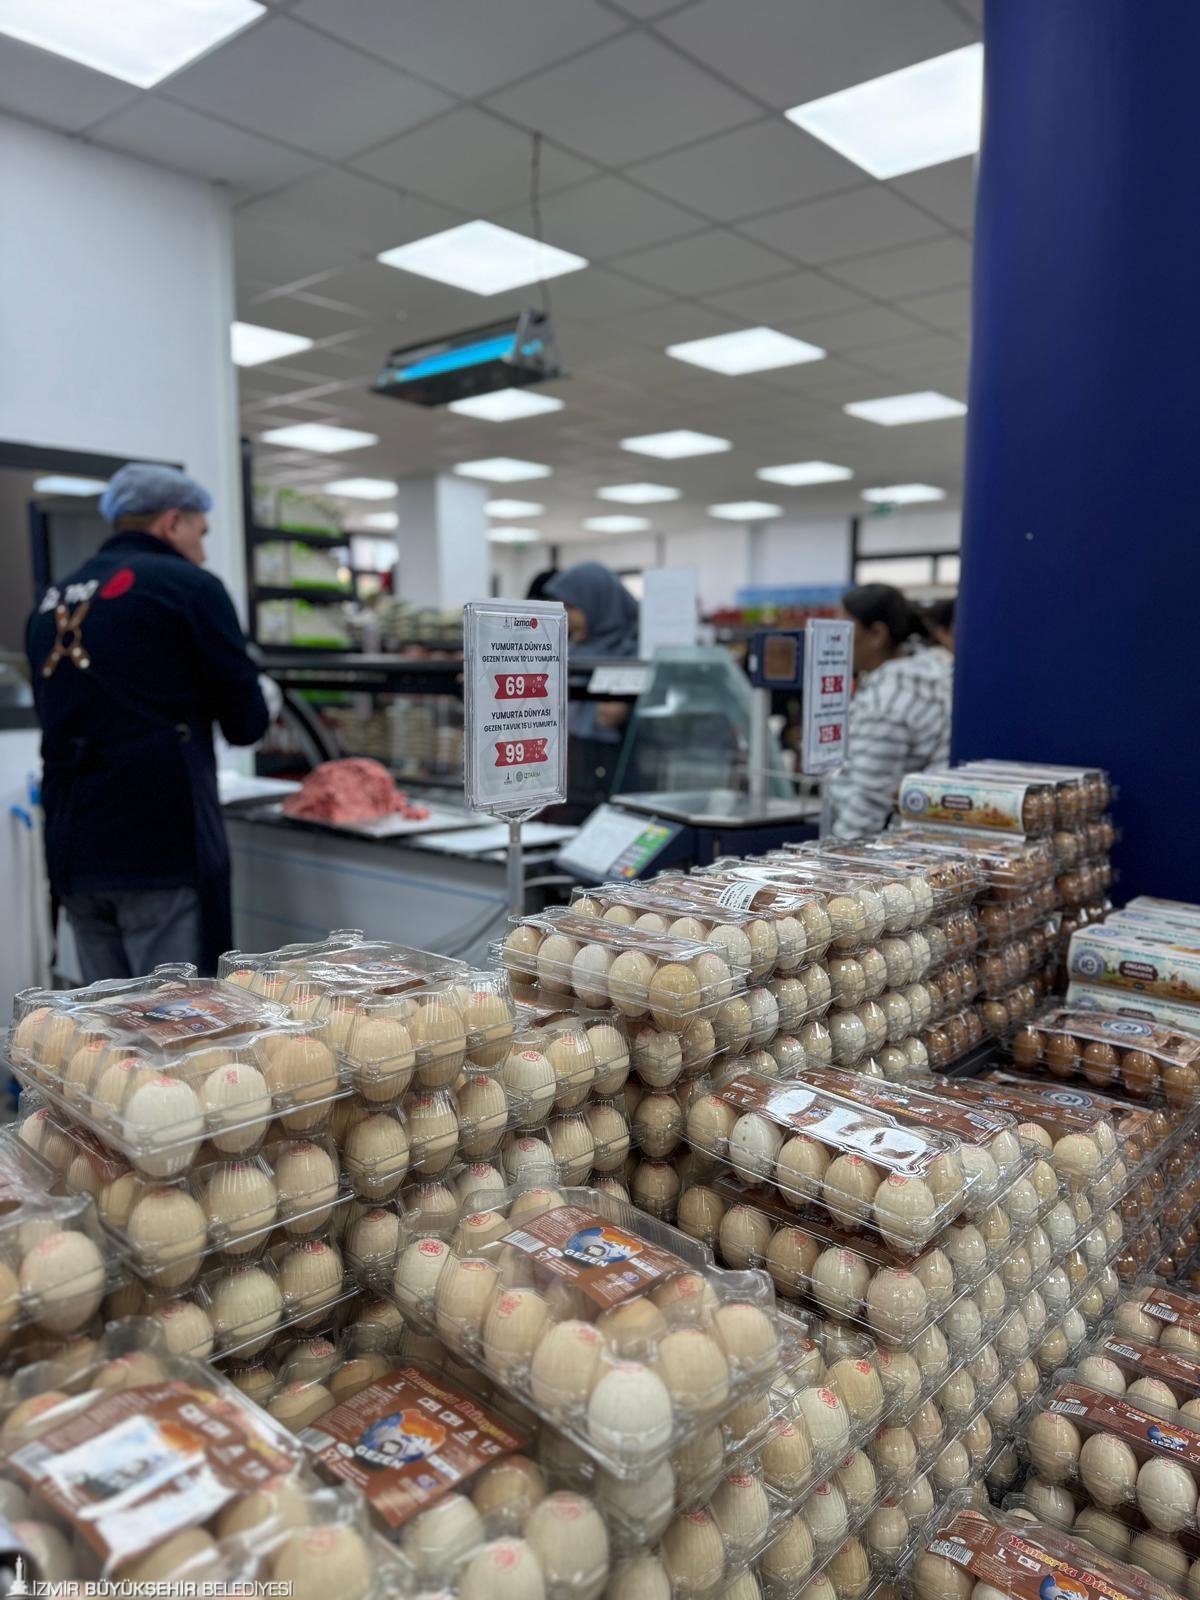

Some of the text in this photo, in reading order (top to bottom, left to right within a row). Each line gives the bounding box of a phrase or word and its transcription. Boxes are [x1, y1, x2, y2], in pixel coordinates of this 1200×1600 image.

[490, 641, 553, 652] YUMURTA DÜNYASI
[481, 655, 501, 663] GEZEN
[501, 655, 520, 663] TAVUK
[534, 655, 560, 664] YUMURTA
[505, 676, 525, 696] 69
[491, 707, 552, 720] YUMURTA DÜNYASI
[483, 725, 503, 733] GEZEN
[502, 723, 521, 731] TAVUK
[532, 719, 558, 730] YUMURTA
[505, 743, 525, 763] 99
[563, 1249, 610, 1268] GEZEN
[355, 1444, 405, 1470] GEZEN
[998, 1548, 1007, 1560] L
[1008, 1534, 1078, 1578] Yumurta
